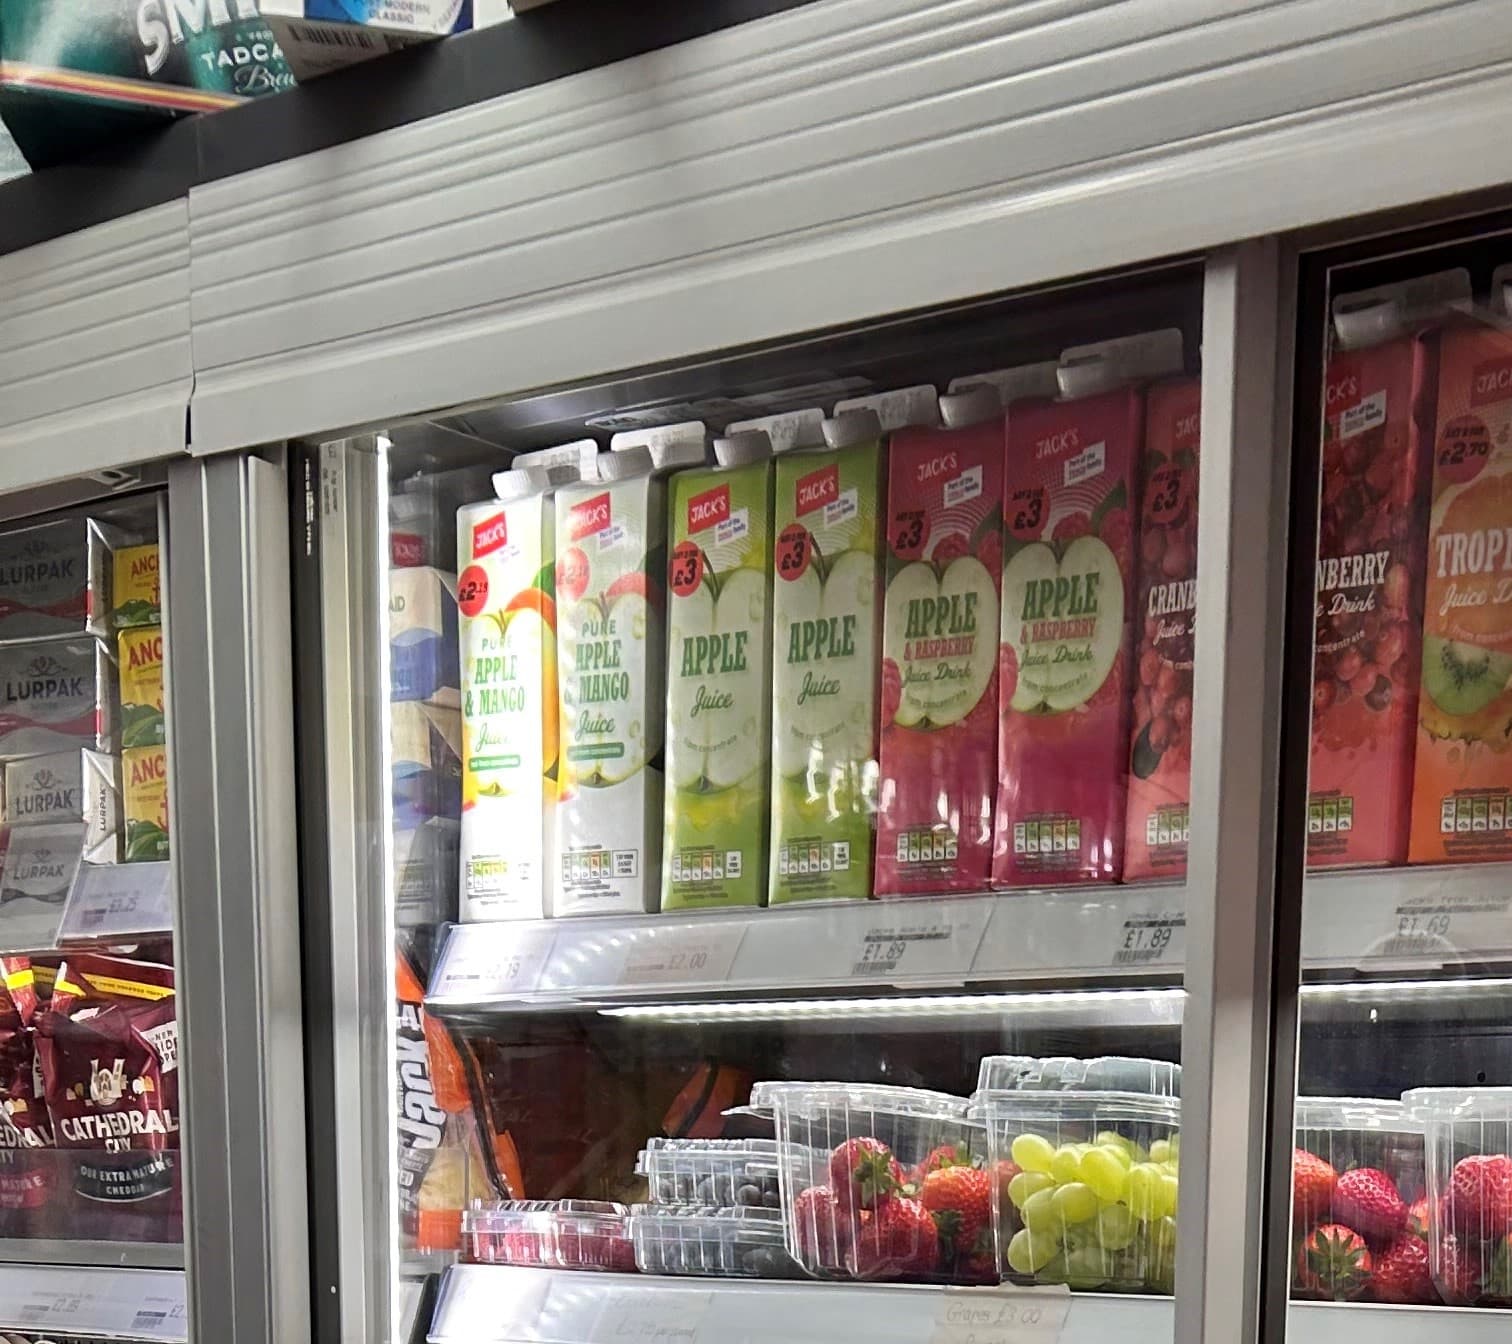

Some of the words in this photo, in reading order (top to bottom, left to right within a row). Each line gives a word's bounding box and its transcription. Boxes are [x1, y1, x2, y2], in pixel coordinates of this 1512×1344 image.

[1036, 428, 1079, 459] JACK'S
[917, 452, 957, 481] JACK'S
[800, 476, 835, 505] JACK'S
[691, 497, 726, 523] JACK'S
[1022, 573, 1099, 619] APPLE
[1327, 591, 1376, 616] Drink
[1440, 584, 1487, 616] Juice
[905, 592, 977, 637] APPLE
[787, 614, 855, 663] APPLE
[1031, 617, 1096, 643] RASPBERRY
[575, 639, 622, 670] APPLE
[682, 630, 748, 677] APPLE
[914, 635, 975, 660] RASPBERRY
[475, 655, 518, 684] APPLE
[6, 677, 84, 701] LURPAK
[479, 687, 524, 716] MANGO
[579, 672, 629, 703] MANGO
[691, 684, 734, 717] Juice
[797, 672, 841, 705] Juice
[575, 710, 614, 741] Juice
[16, 788, 75, 815] LURPAK
[862, 943, 906, 961] £1.89
[1124, 928, 1172, 949] £1.89
[60, 1109, 178, 1141] CATHEDRAL
[100, 1169, 132, 1182] EXTRA
